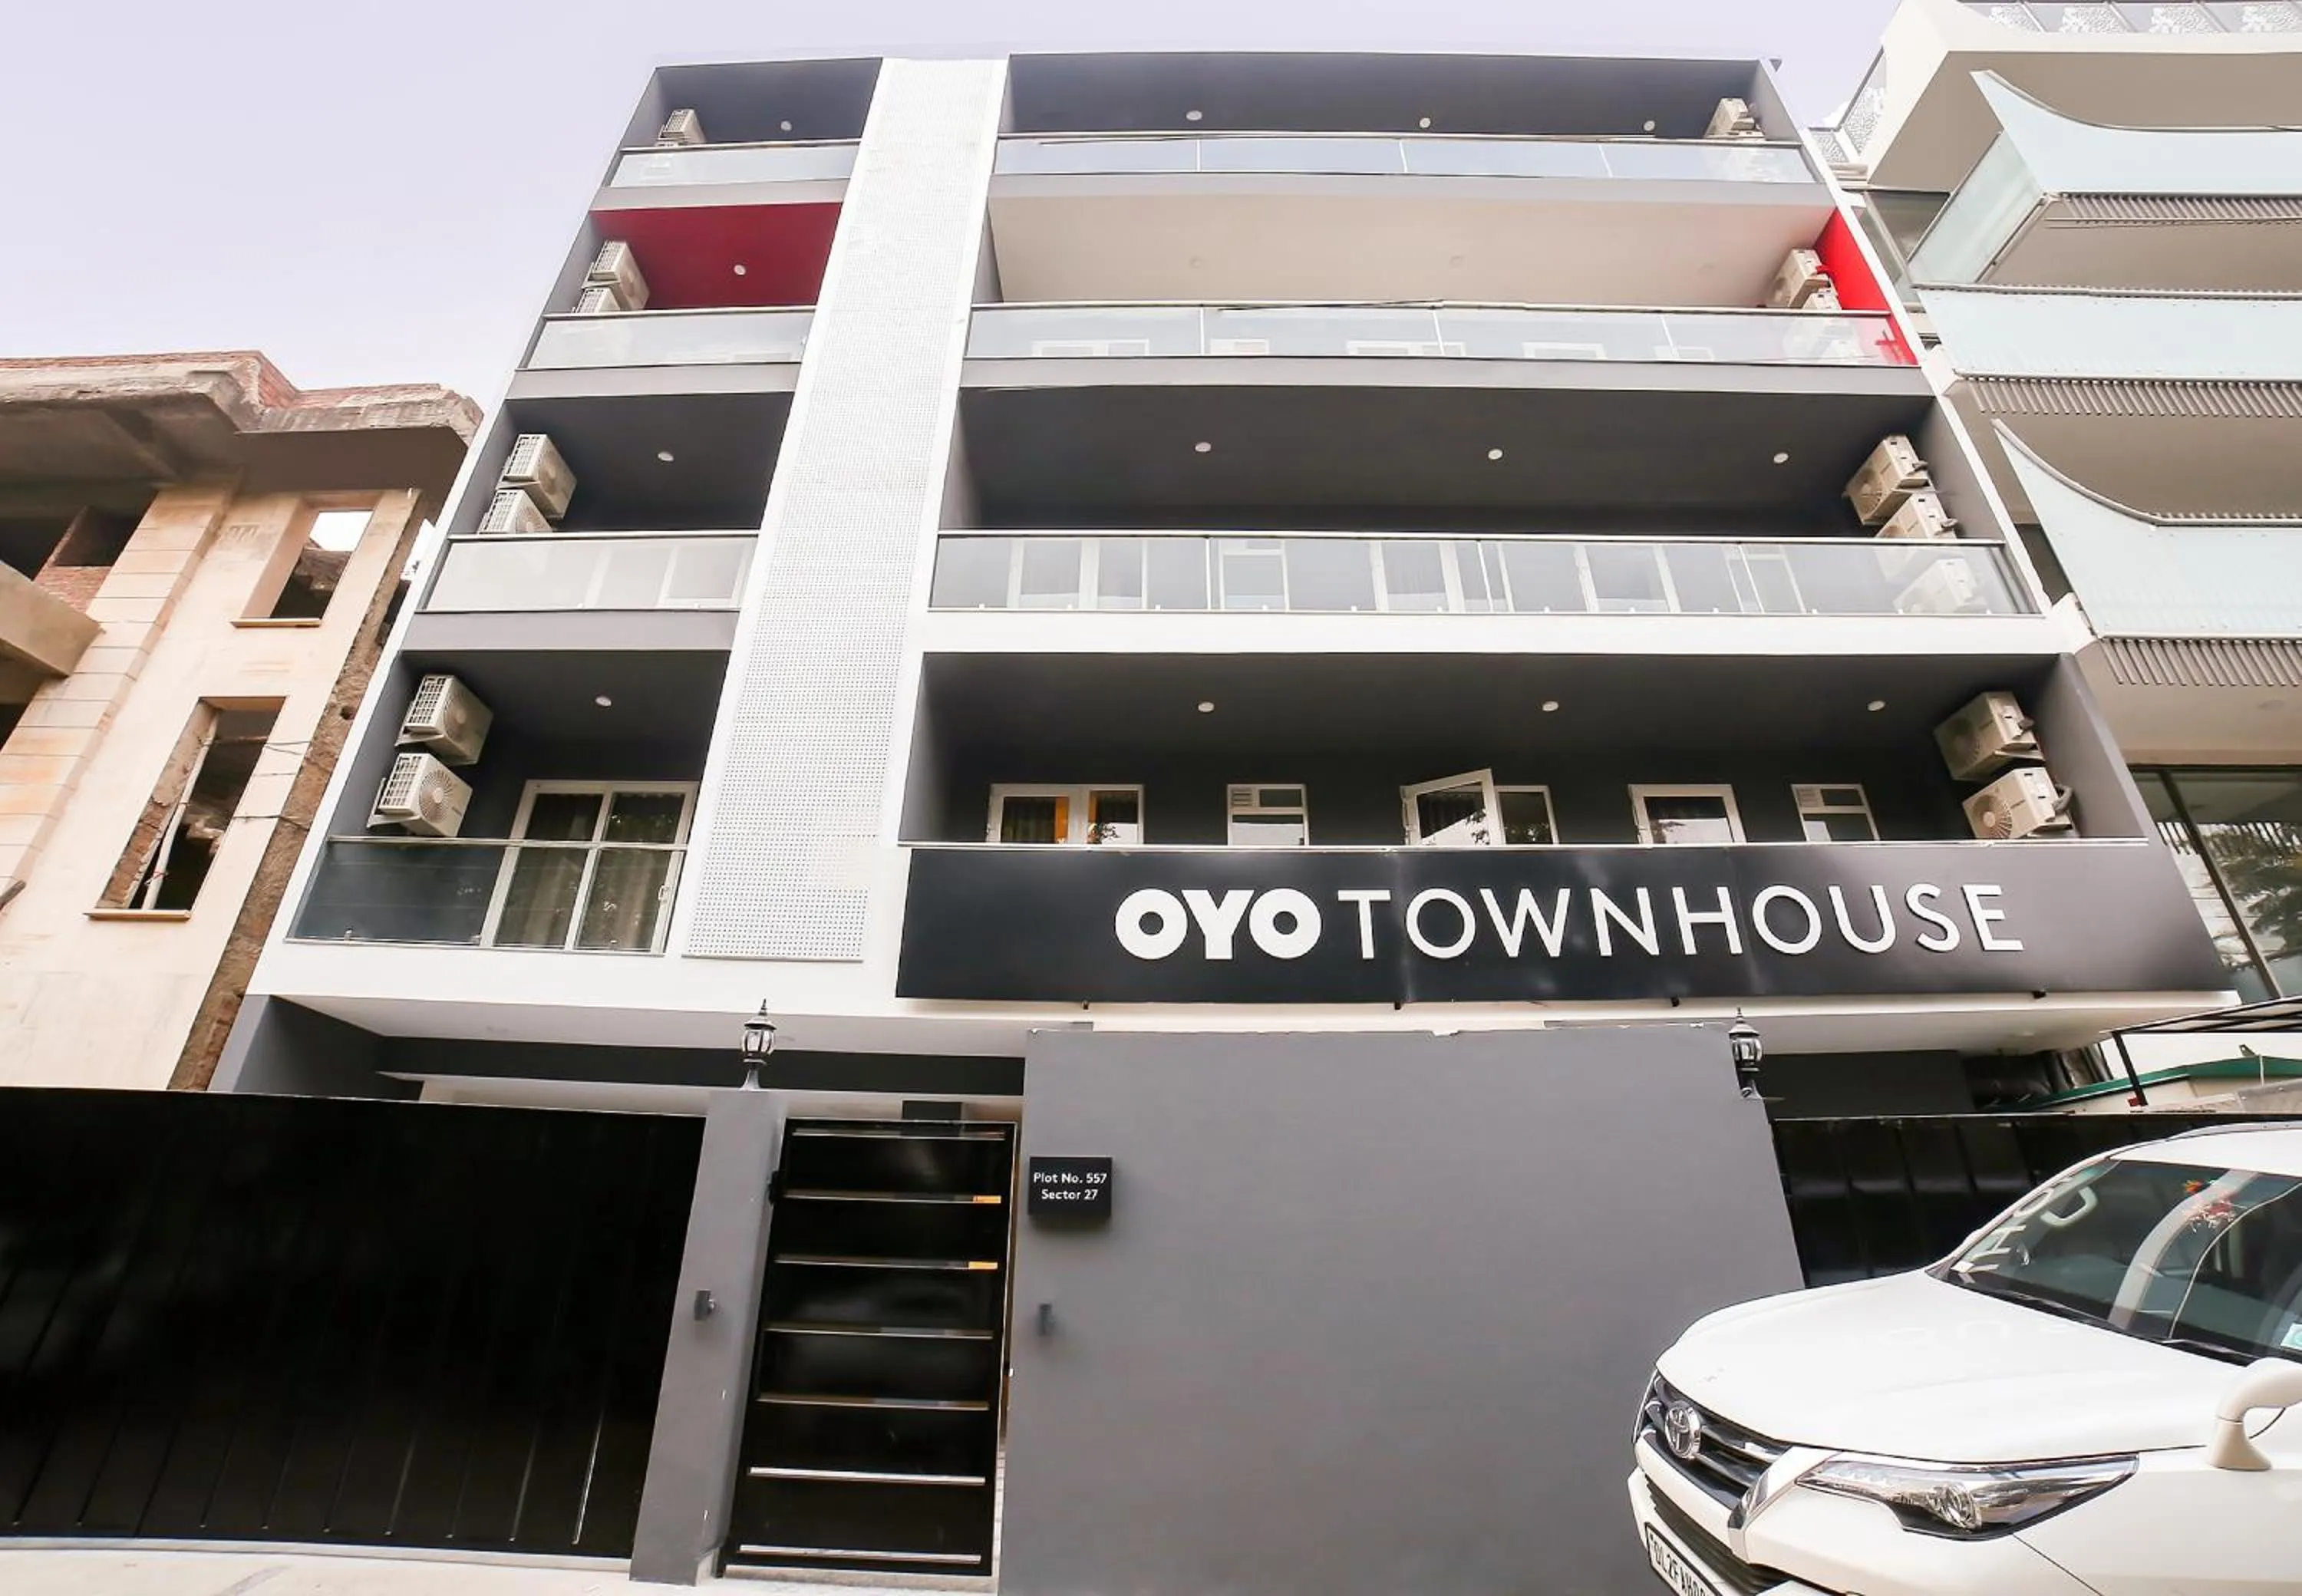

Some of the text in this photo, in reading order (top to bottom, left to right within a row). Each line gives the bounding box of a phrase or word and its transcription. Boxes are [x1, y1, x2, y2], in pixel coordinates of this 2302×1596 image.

[1115, 883, 2025, 959] OYO TOWNHOUSE
[1034, 1172, 1107, 1183] Plot No. 557
[1041, 1189, 1098, 1200] Sector 27
